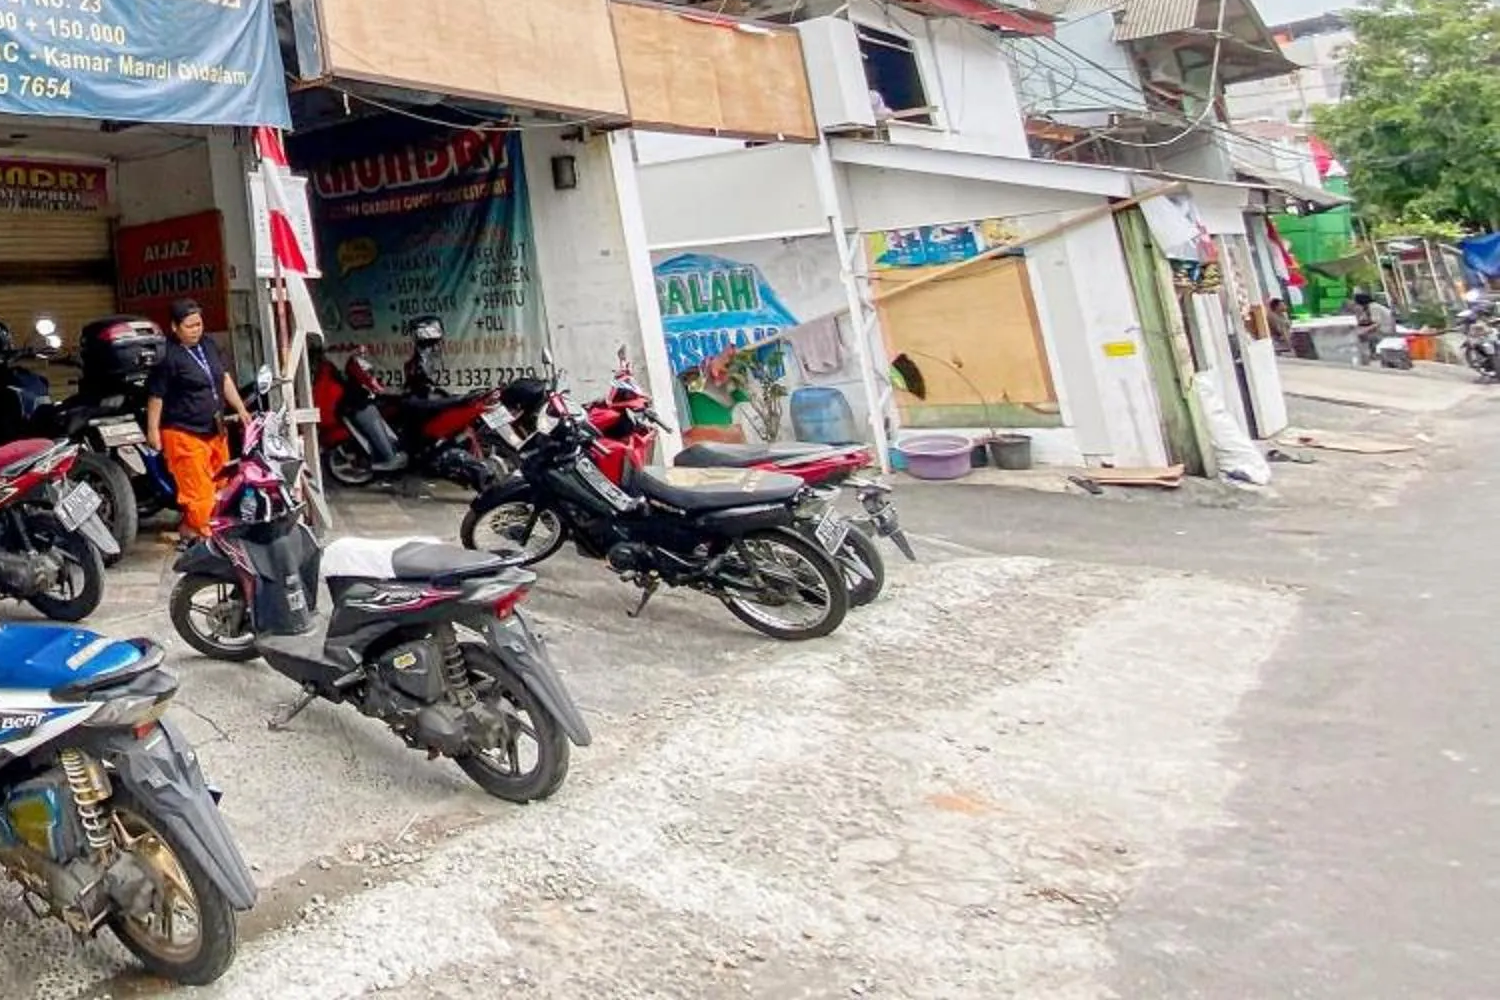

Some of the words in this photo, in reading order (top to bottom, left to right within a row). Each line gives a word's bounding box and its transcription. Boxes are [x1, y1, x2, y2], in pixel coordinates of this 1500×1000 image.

[48, 16, 126, 47] 150.000
[44, 46, 112, 74] Kamar
[119, 55, 171, 81] Mandi
[18, 74, 72, 100] 7654
[143, 239, 192, 264] AIJAZ
[119, 264, 216, 300] LAUNDRY
[456, 367, 492, 387] 1332
